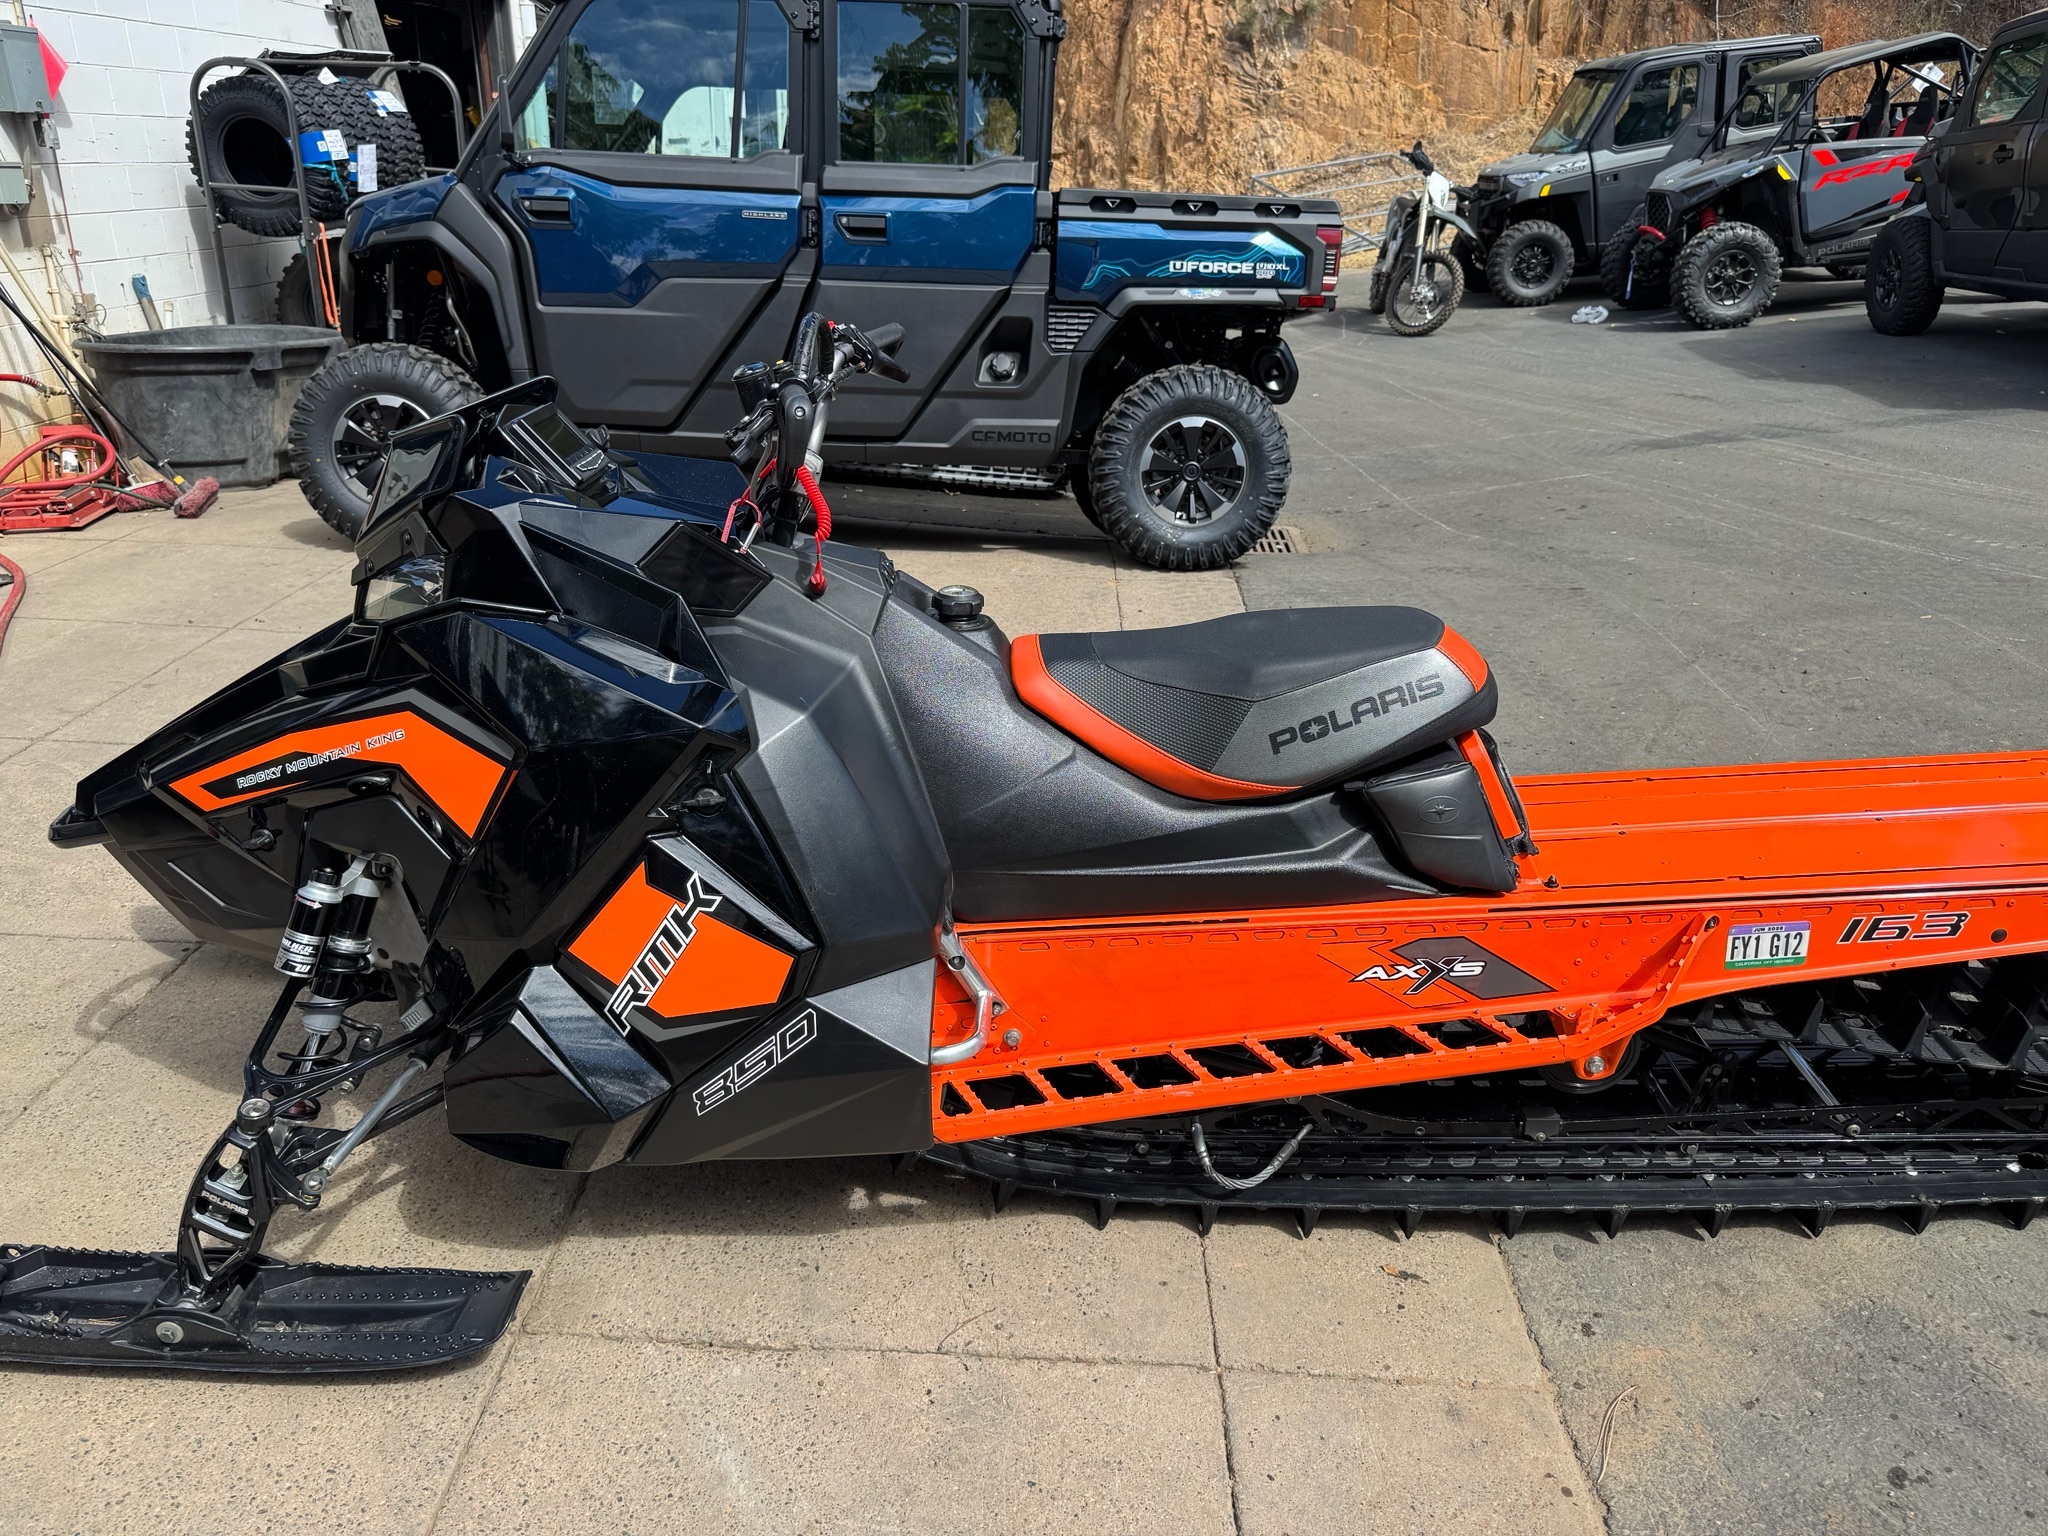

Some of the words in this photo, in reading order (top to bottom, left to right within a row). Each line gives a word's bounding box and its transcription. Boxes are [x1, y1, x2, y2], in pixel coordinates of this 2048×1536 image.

[1812, 152, 1917, 192] RZR
[1818, 238, 1871, 256] POLARIS
[1169, 260, 1254, 274] UFORCE
[971, 430, 1052, 443] CFMOTO
[1268, 672, 1445, 756] POLARIS
[236, 765, 283, 788] ROCKY
[285, 742, 362, 774] MOUNTAIN
[365, 729, 405, 750] KING
[1836, 911, 1971, 944] 163
[603, 870, 723, 1037] RMK
[1730, 934, 1761, 960] FY1
[1769, 932, 1803, 958] G12
[1350, 955, 1487, 995] AXYS
[692, 1008, 817, 1116] 850
[201, 1190, 249, 1216] POLARIS
